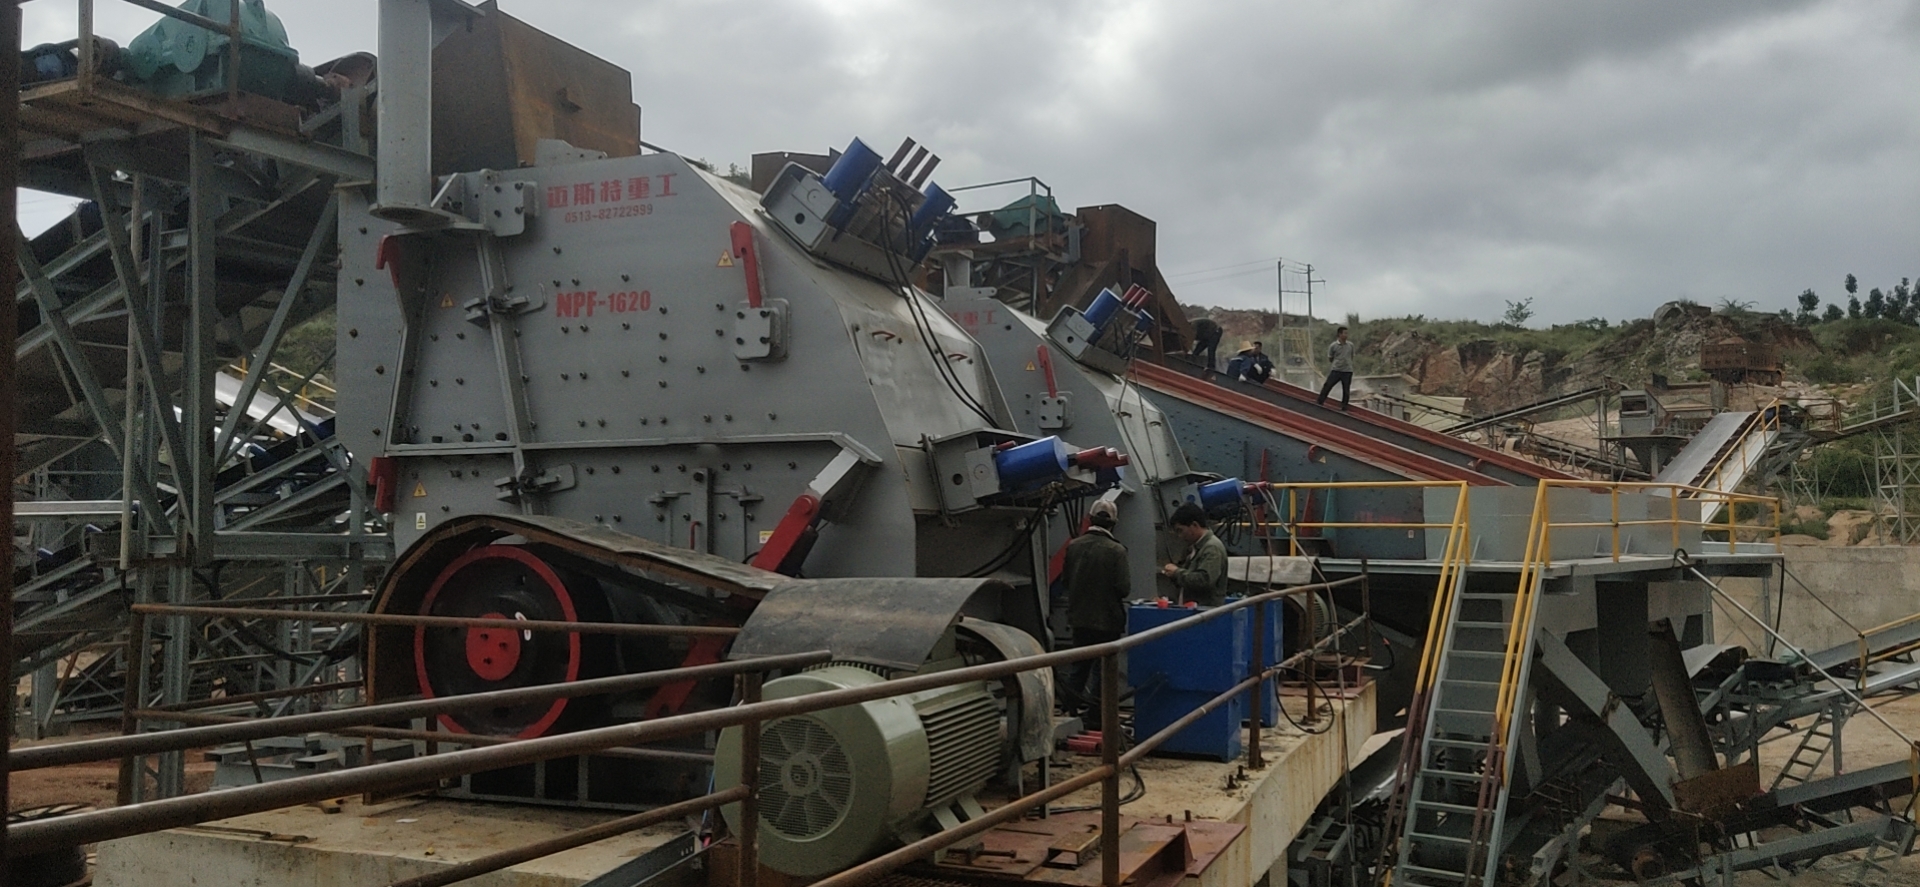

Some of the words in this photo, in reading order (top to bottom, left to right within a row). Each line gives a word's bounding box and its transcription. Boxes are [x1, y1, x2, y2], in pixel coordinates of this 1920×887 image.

[547, 173, 678, 208] 迈斯特重工
[564, 204, 653, 223] 0513-82722999
[556, 290, 651, 318] NPF-1620
